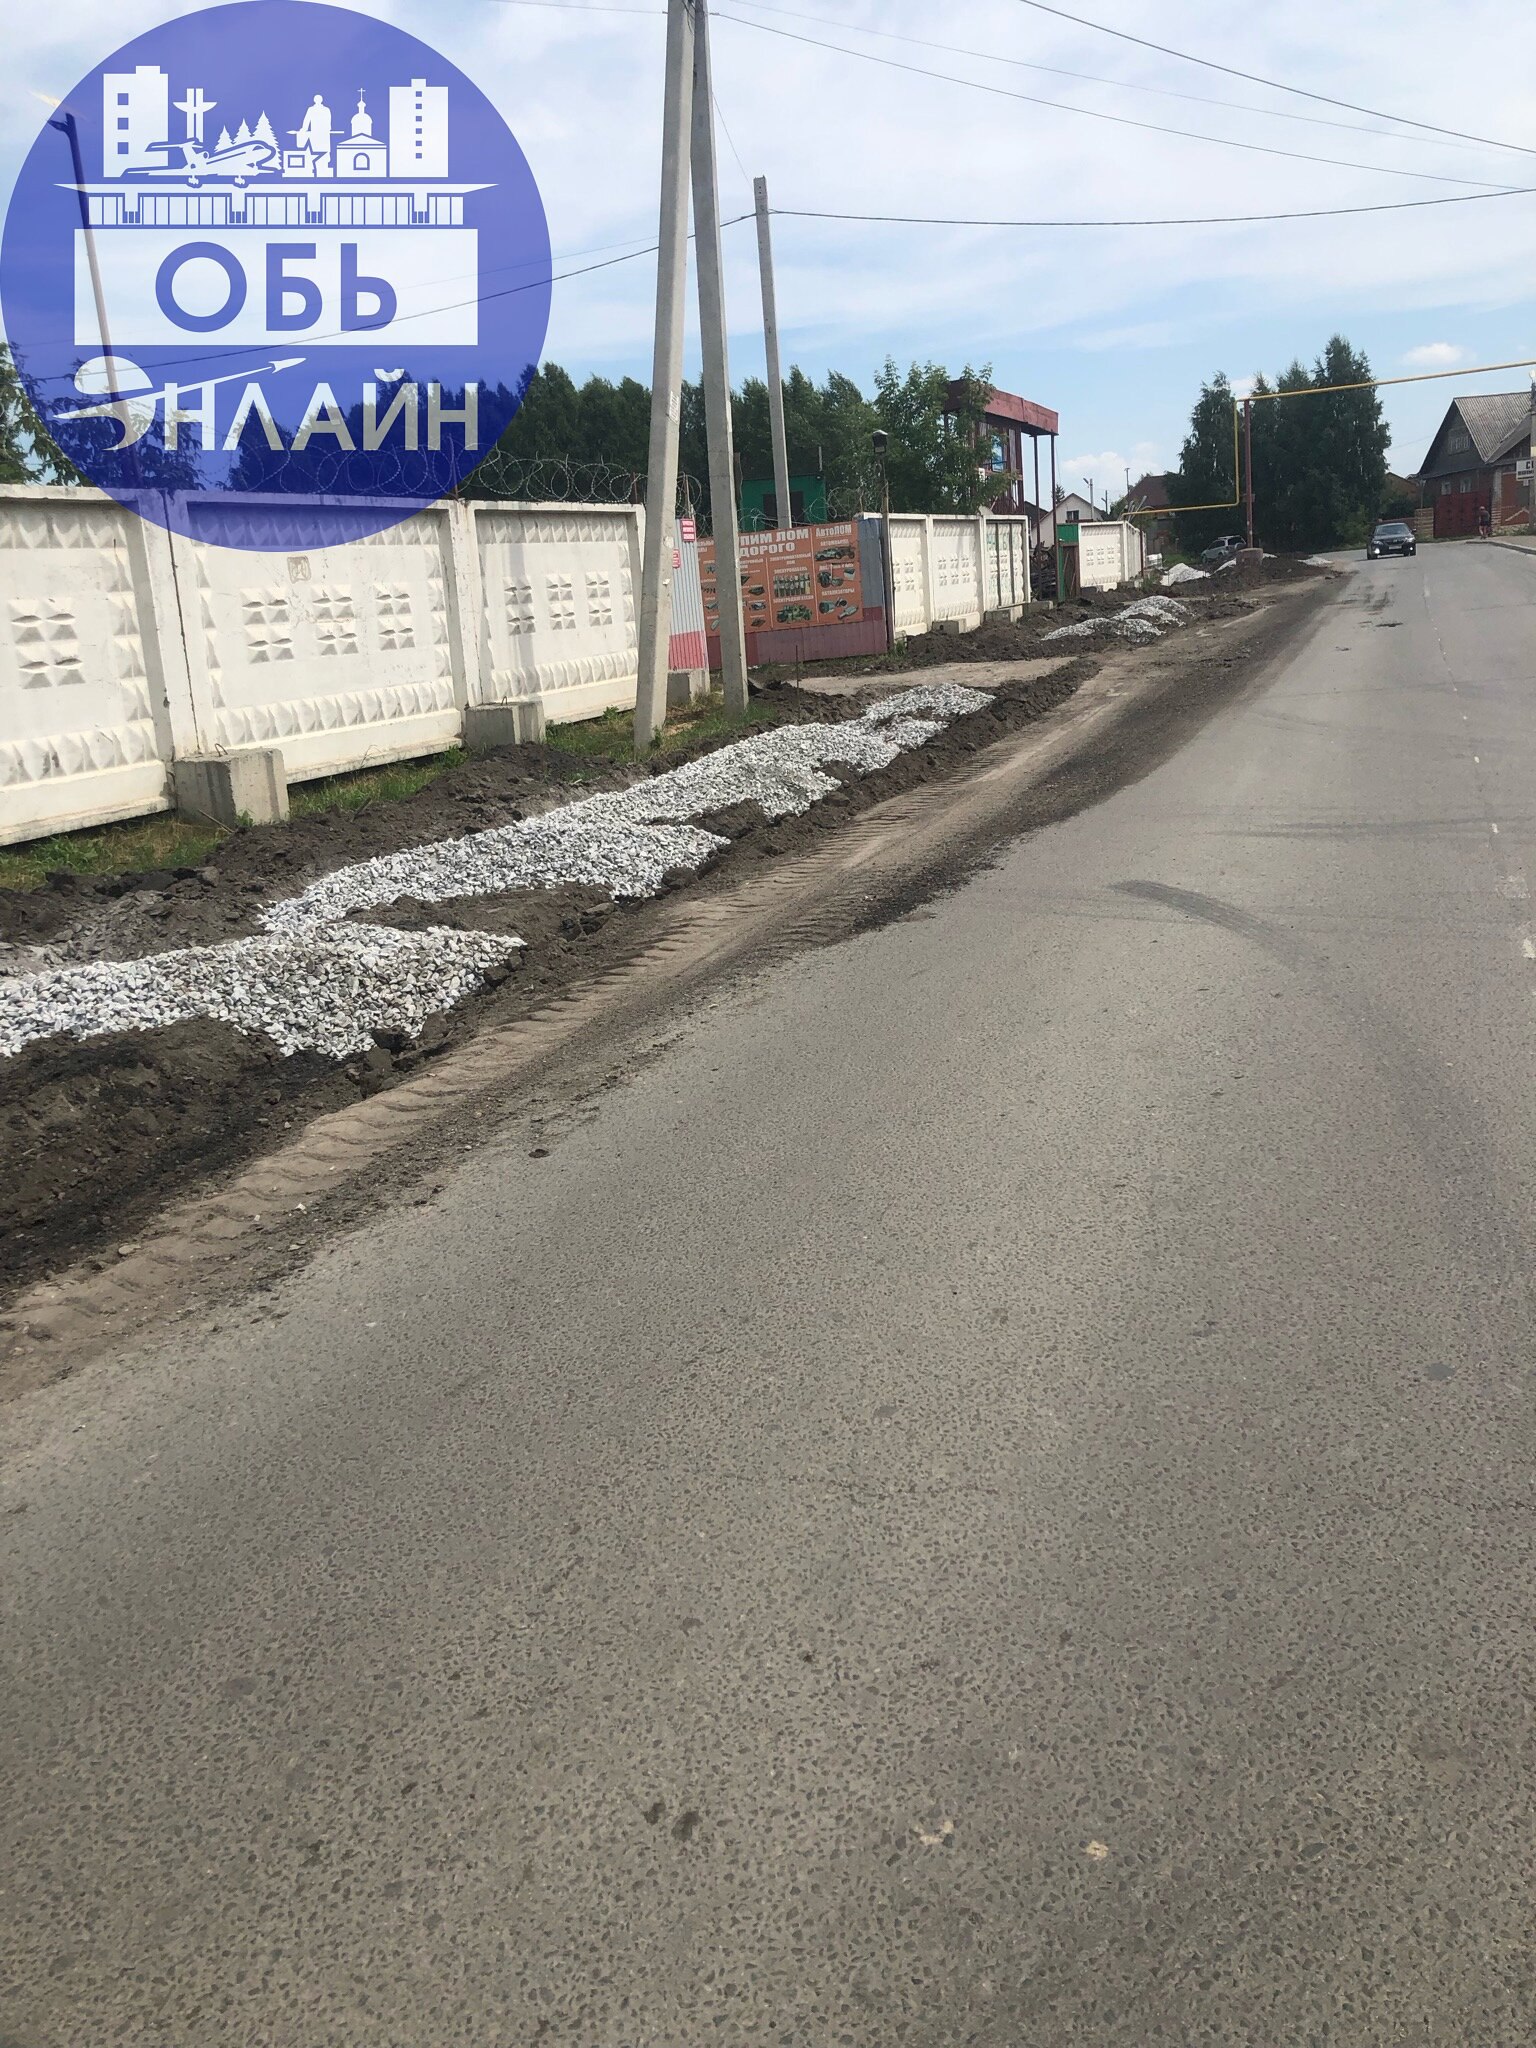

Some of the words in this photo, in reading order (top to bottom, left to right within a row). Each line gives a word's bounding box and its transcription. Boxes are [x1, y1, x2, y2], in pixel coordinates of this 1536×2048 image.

[740, 533, 772, 546] ПИМ
[776, 529, 809, 542] ЛОМ
[739, 542, 796, 558] ДОРОГО
